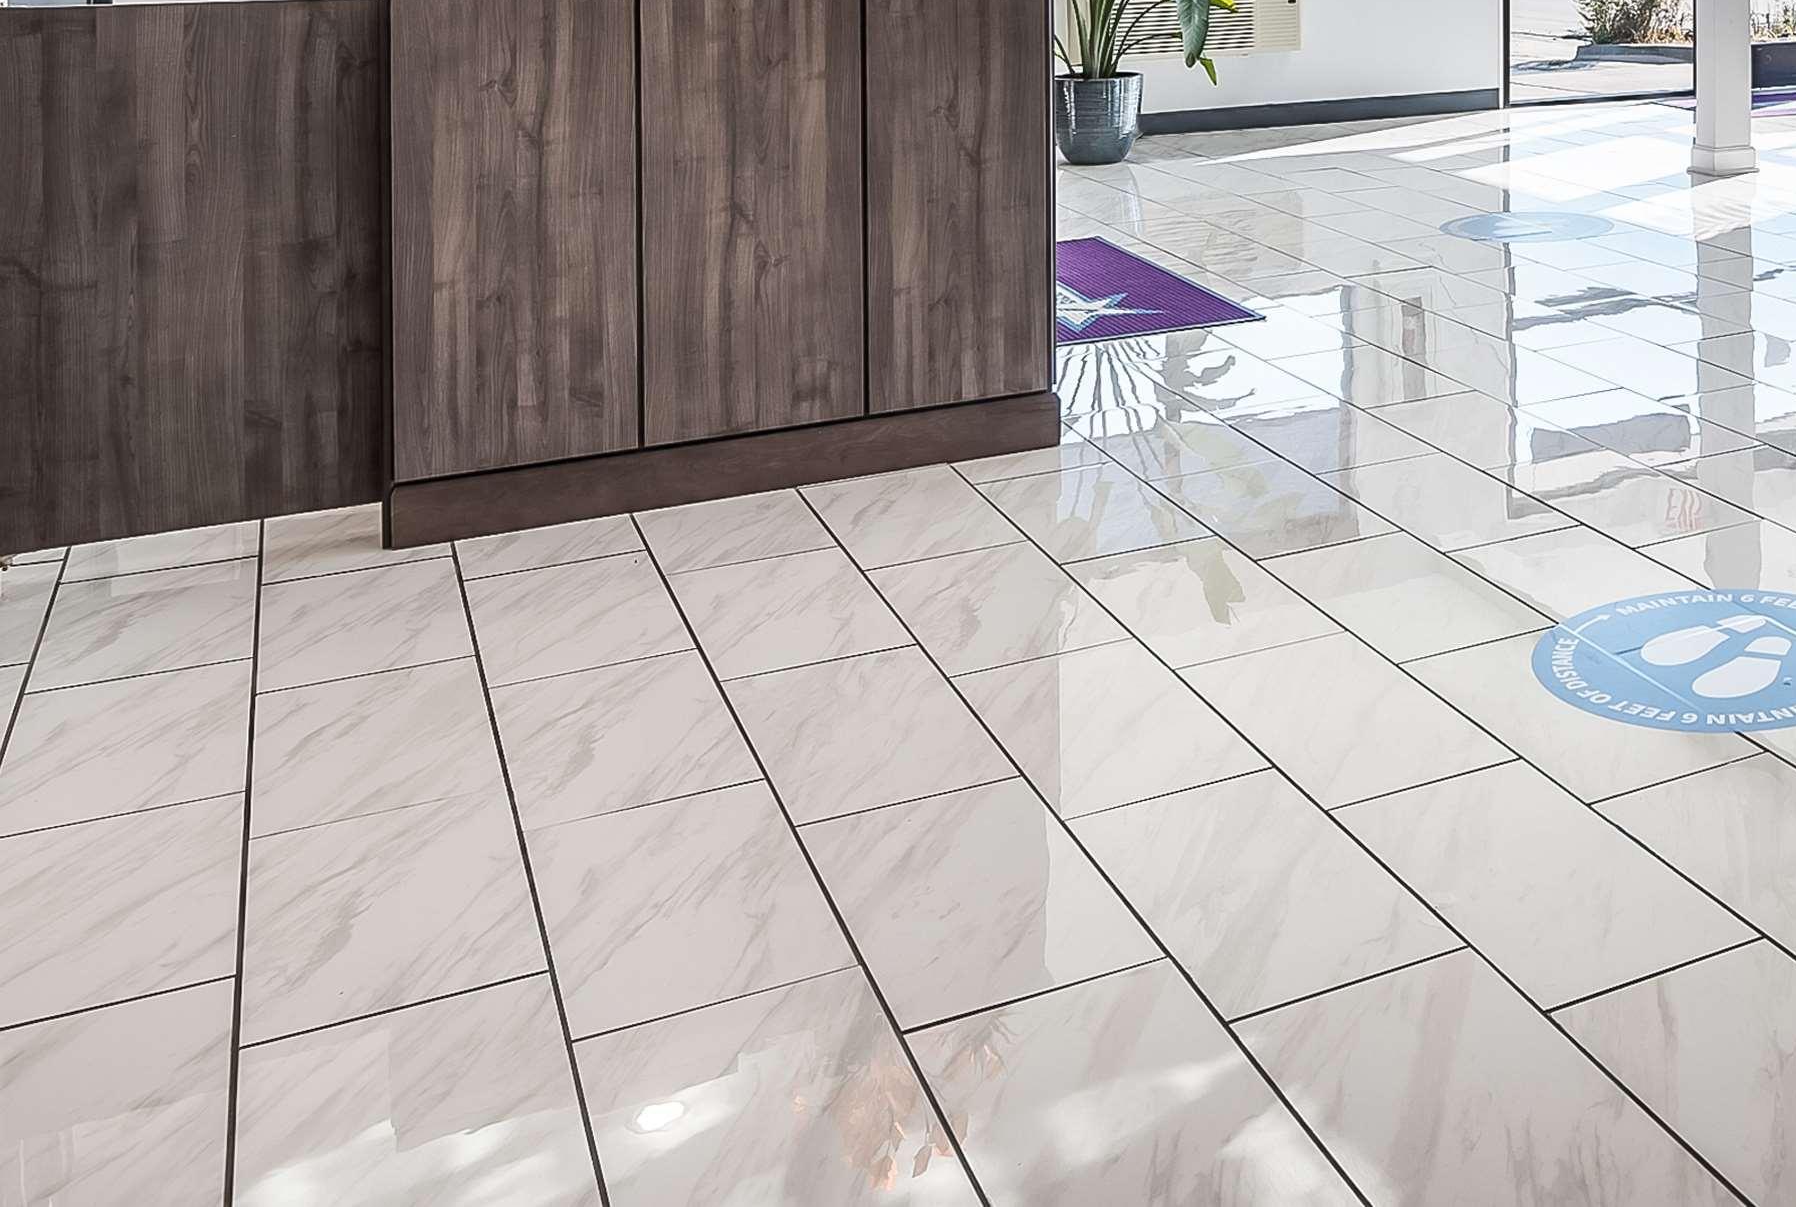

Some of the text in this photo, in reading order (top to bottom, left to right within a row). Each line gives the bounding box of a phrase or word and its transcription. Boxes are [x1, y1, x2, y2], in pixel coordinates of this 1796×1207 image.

[1615, 593, 1732, 616] MAINTAIN
[1740, 594, 1754, 603] 6
[1551, 637, 1589, 690] DISTANCE
[1576, 689, 1612, 704] OF
[1608, 700, 1677, 722] FEET
[1680, 712, 1698, 725] 6
